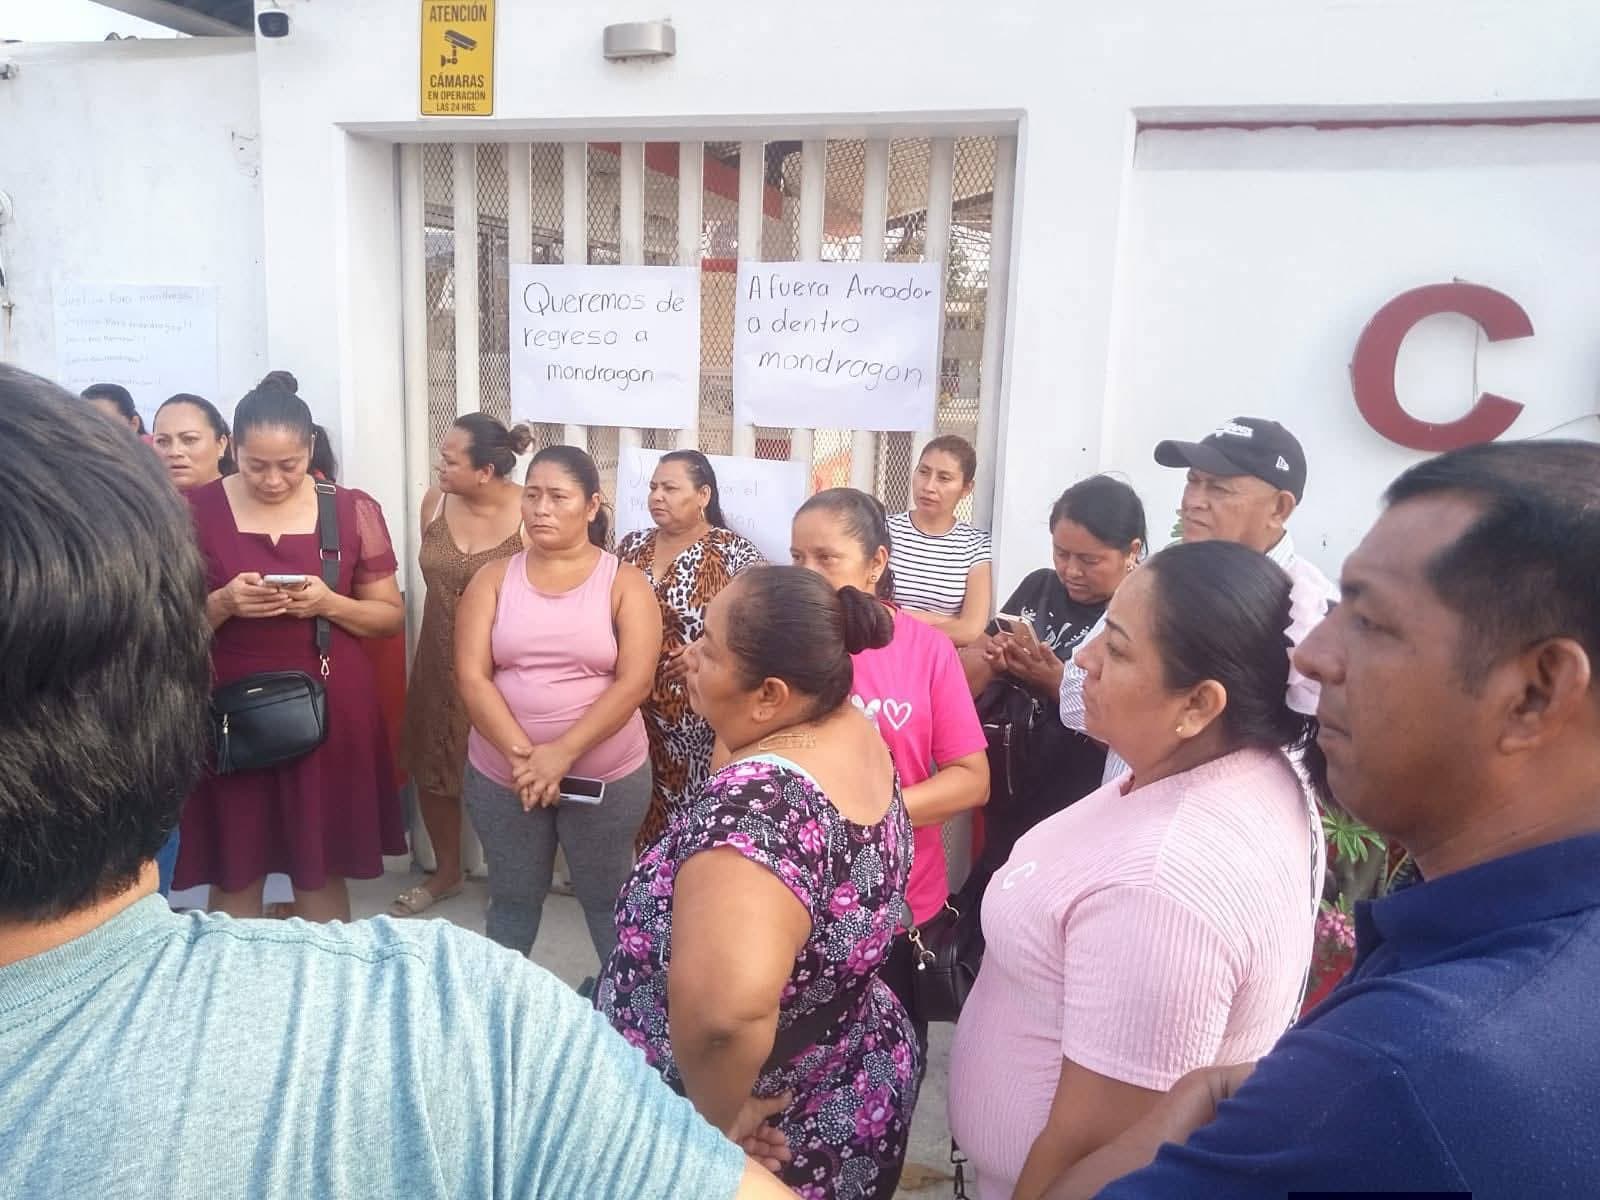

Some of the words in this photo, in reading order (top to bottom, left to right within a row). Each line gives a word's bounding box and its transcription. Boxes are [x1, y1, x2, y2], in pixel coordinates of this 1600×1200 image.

[430, 1, 487, 22] ATENCIÓN
[430, 72, 485, 89] CÁMARAS
[428, 91, 439, 100] EN
[441, 90, 486, 101] OPERACIÓN
[437, 103, 449, 112] LAS
[451, 103, 460, 111] 24
[846, 273, 934, 301] Amador
[523, 281, 646, 317] Queremos
[656, 289, 685, 313] de
[523, 327, 618, 350] regreso
[635, 330, 648, 343] a
[547, 359, 655, 391] mondragon
[758, 349, 923, 391] mondragon
